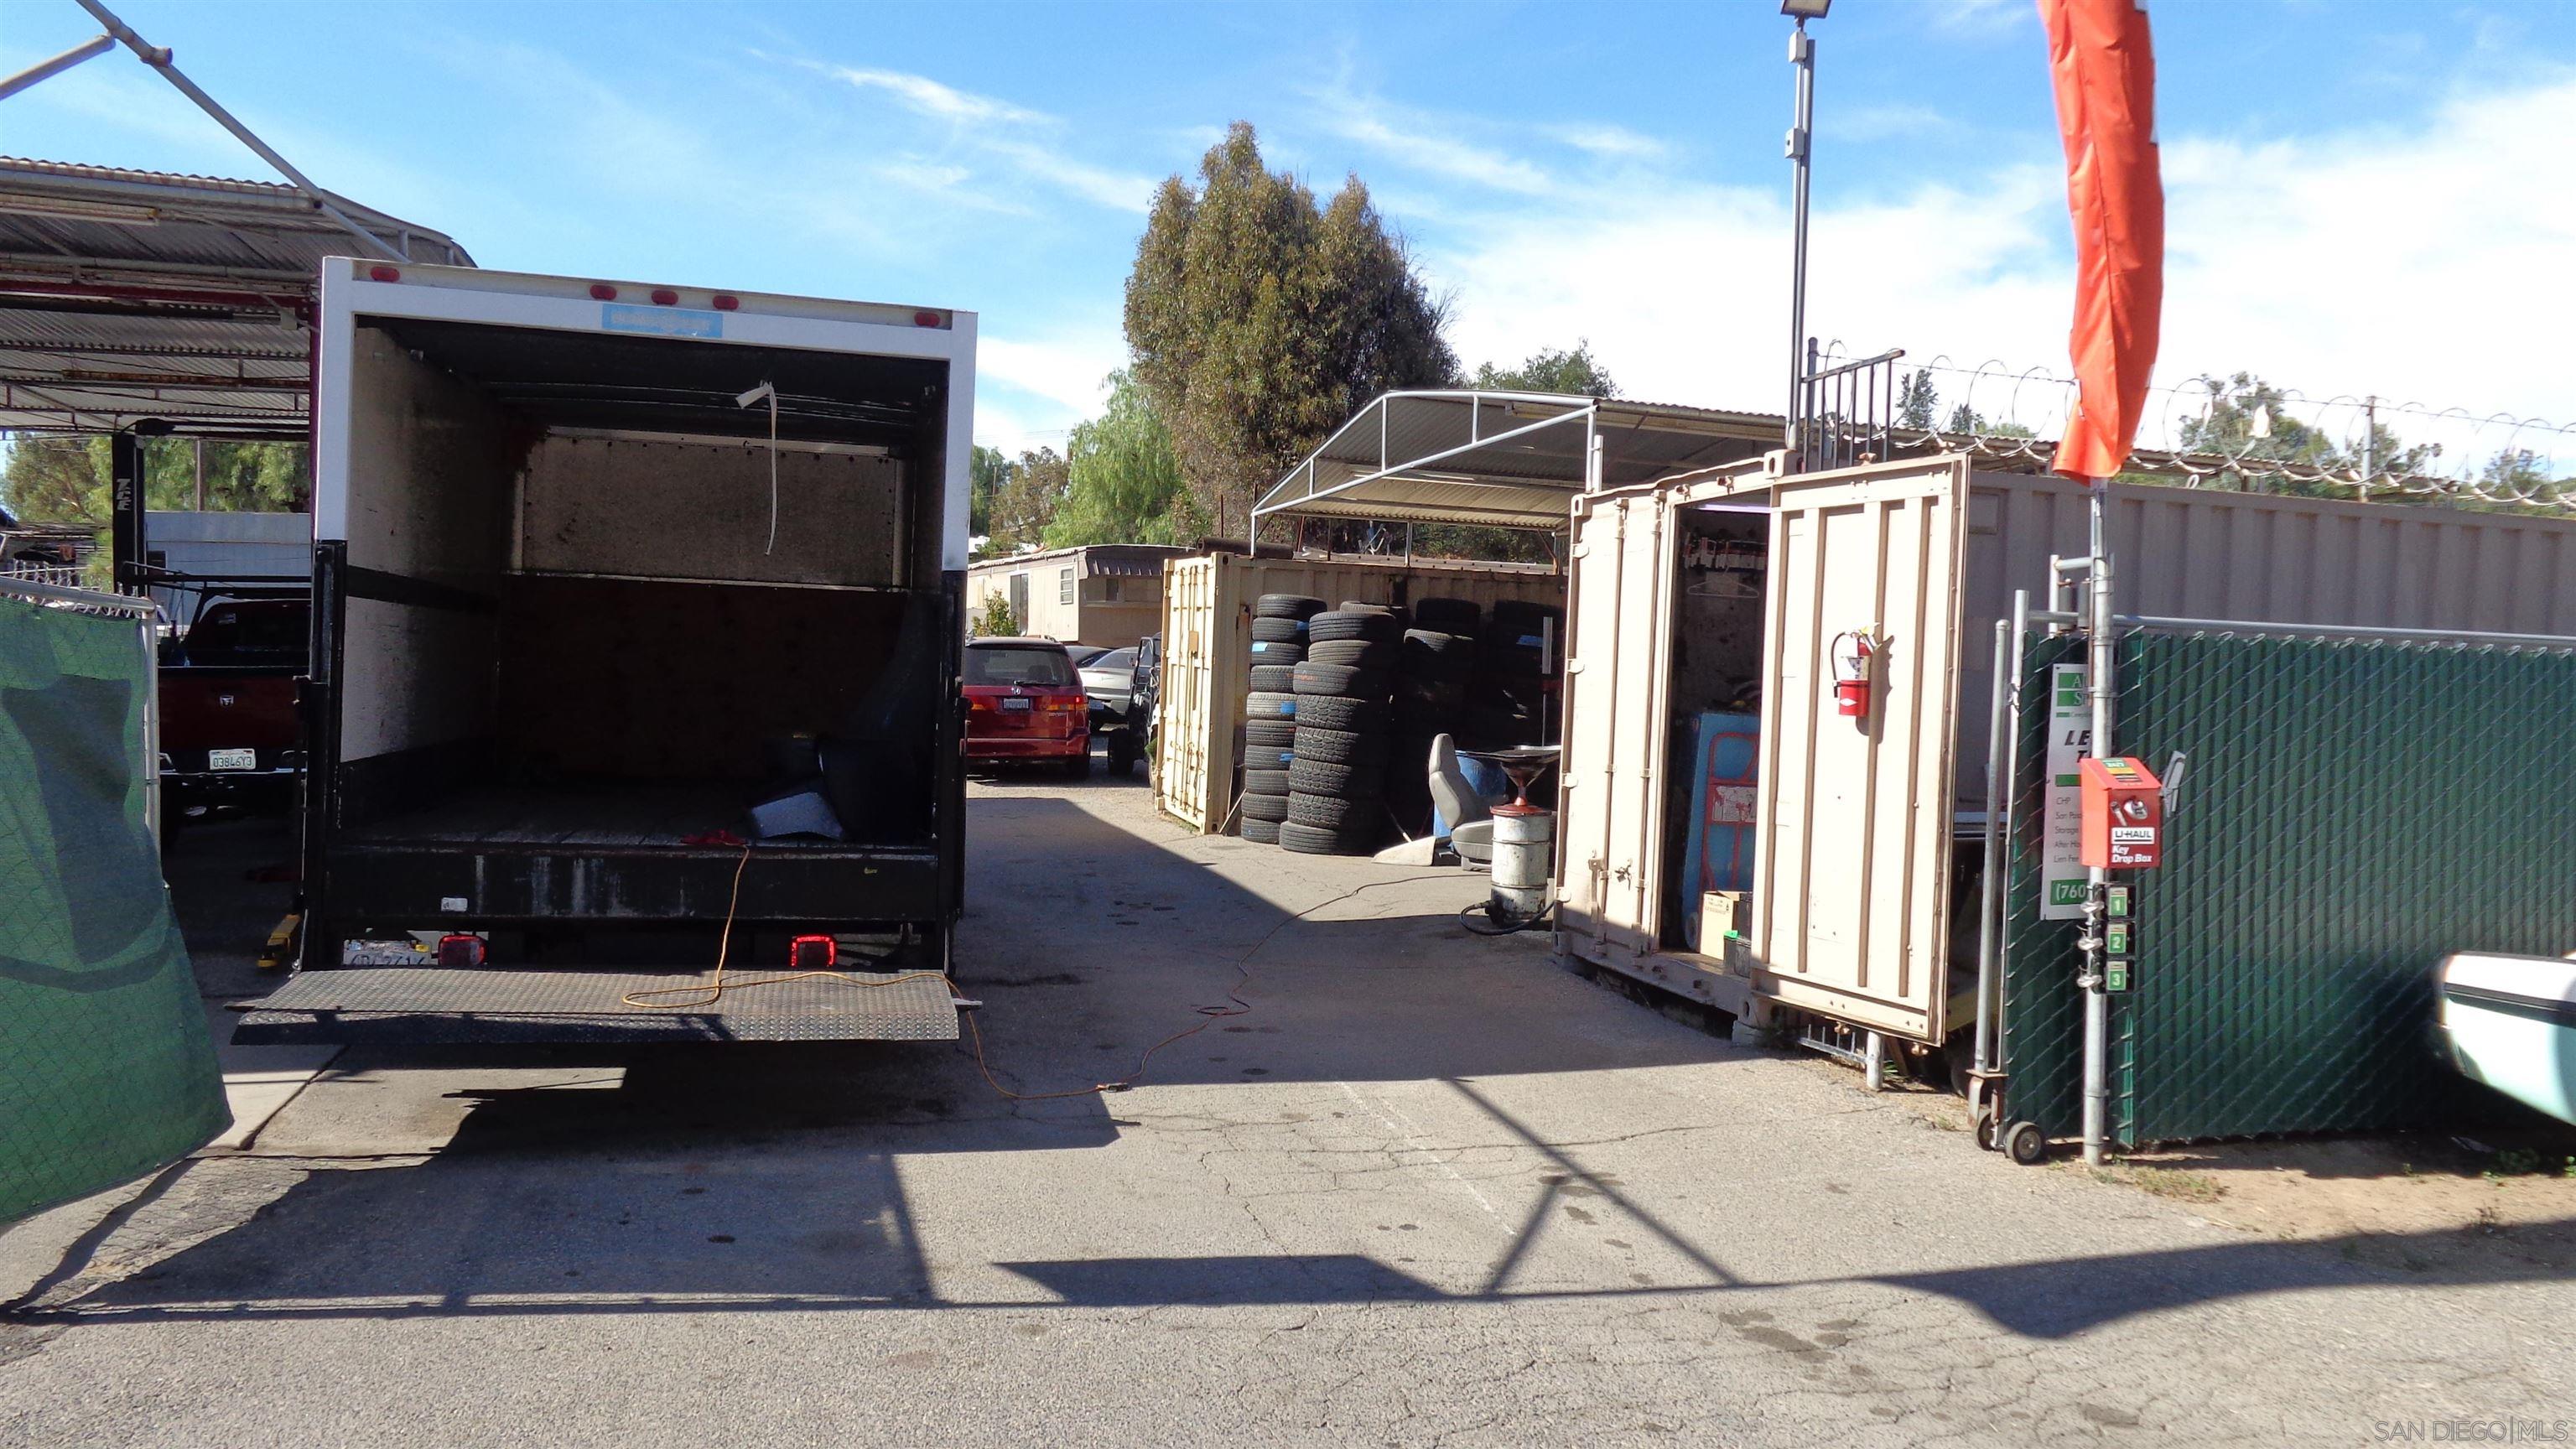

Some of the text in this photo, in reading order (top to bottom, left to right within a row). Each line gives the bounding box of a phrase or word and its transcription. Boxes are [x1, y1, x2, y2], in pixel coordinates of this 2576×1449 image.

[2112, 845, 2130, 855] Key
[2111, 854, 2153, 865] Drop Box
[2115, 899, 2121, 911] 1
[2113, 936, 2121, 949] 2
[2113, 974, 2121, 986] 3
